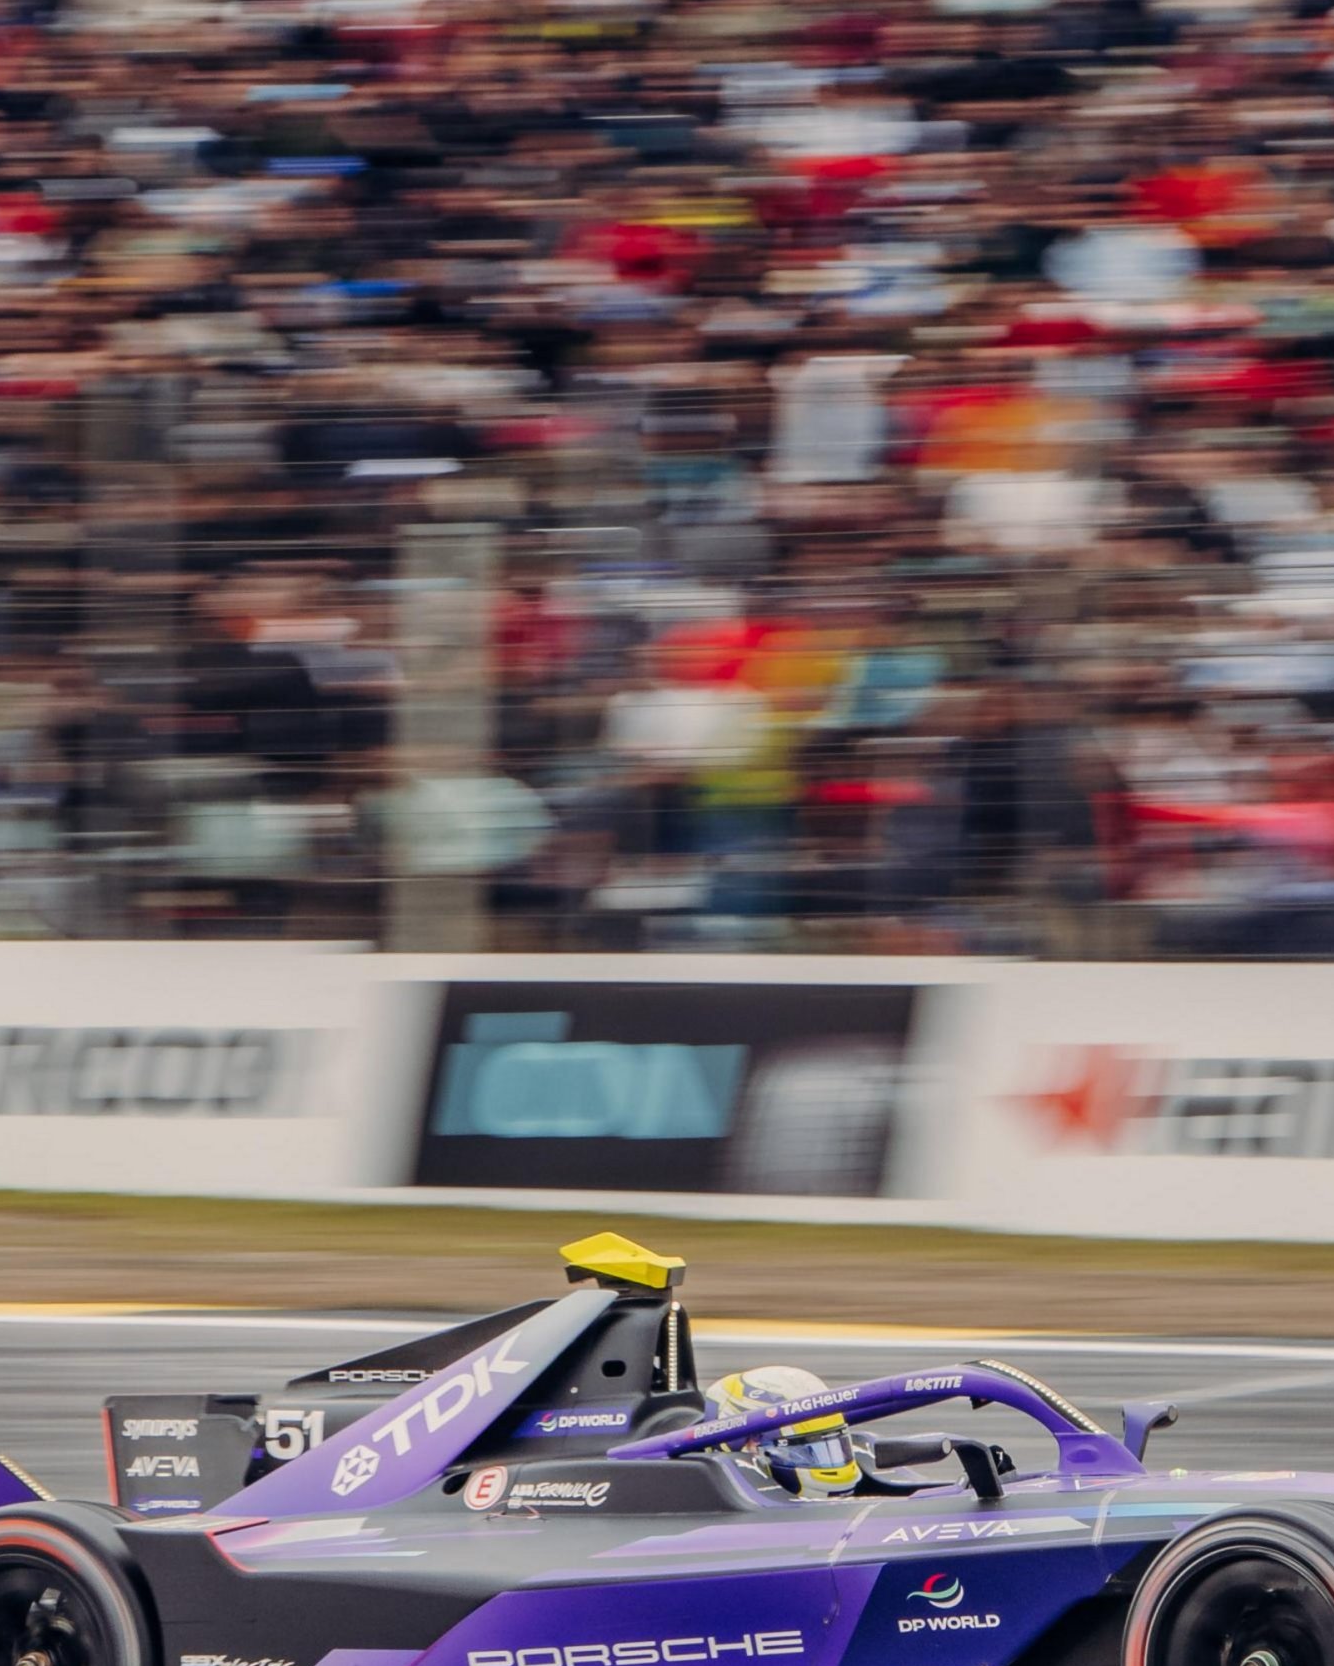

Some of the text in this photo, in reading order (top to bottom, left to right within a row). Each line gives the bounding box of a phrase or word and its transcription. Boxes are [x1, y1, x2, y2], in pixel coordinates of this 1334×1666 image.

[329, 1370, 439, 1382] PORSCH
[904, 1376, 963, 1392] LOCTITE
[372, 1331, 529, 1456] TDK
[559, 1413, 627, 1428] DP WORLD
[265, 1410, 324, 1460] 51
[126, 1456, 201, 1477] AVEVA
[533, 1482, 591, 1498] FORMULA
[881, 1521, 1020, 1543] AVEVA
[898, 1614, 1001, 1633] DP WORLD
